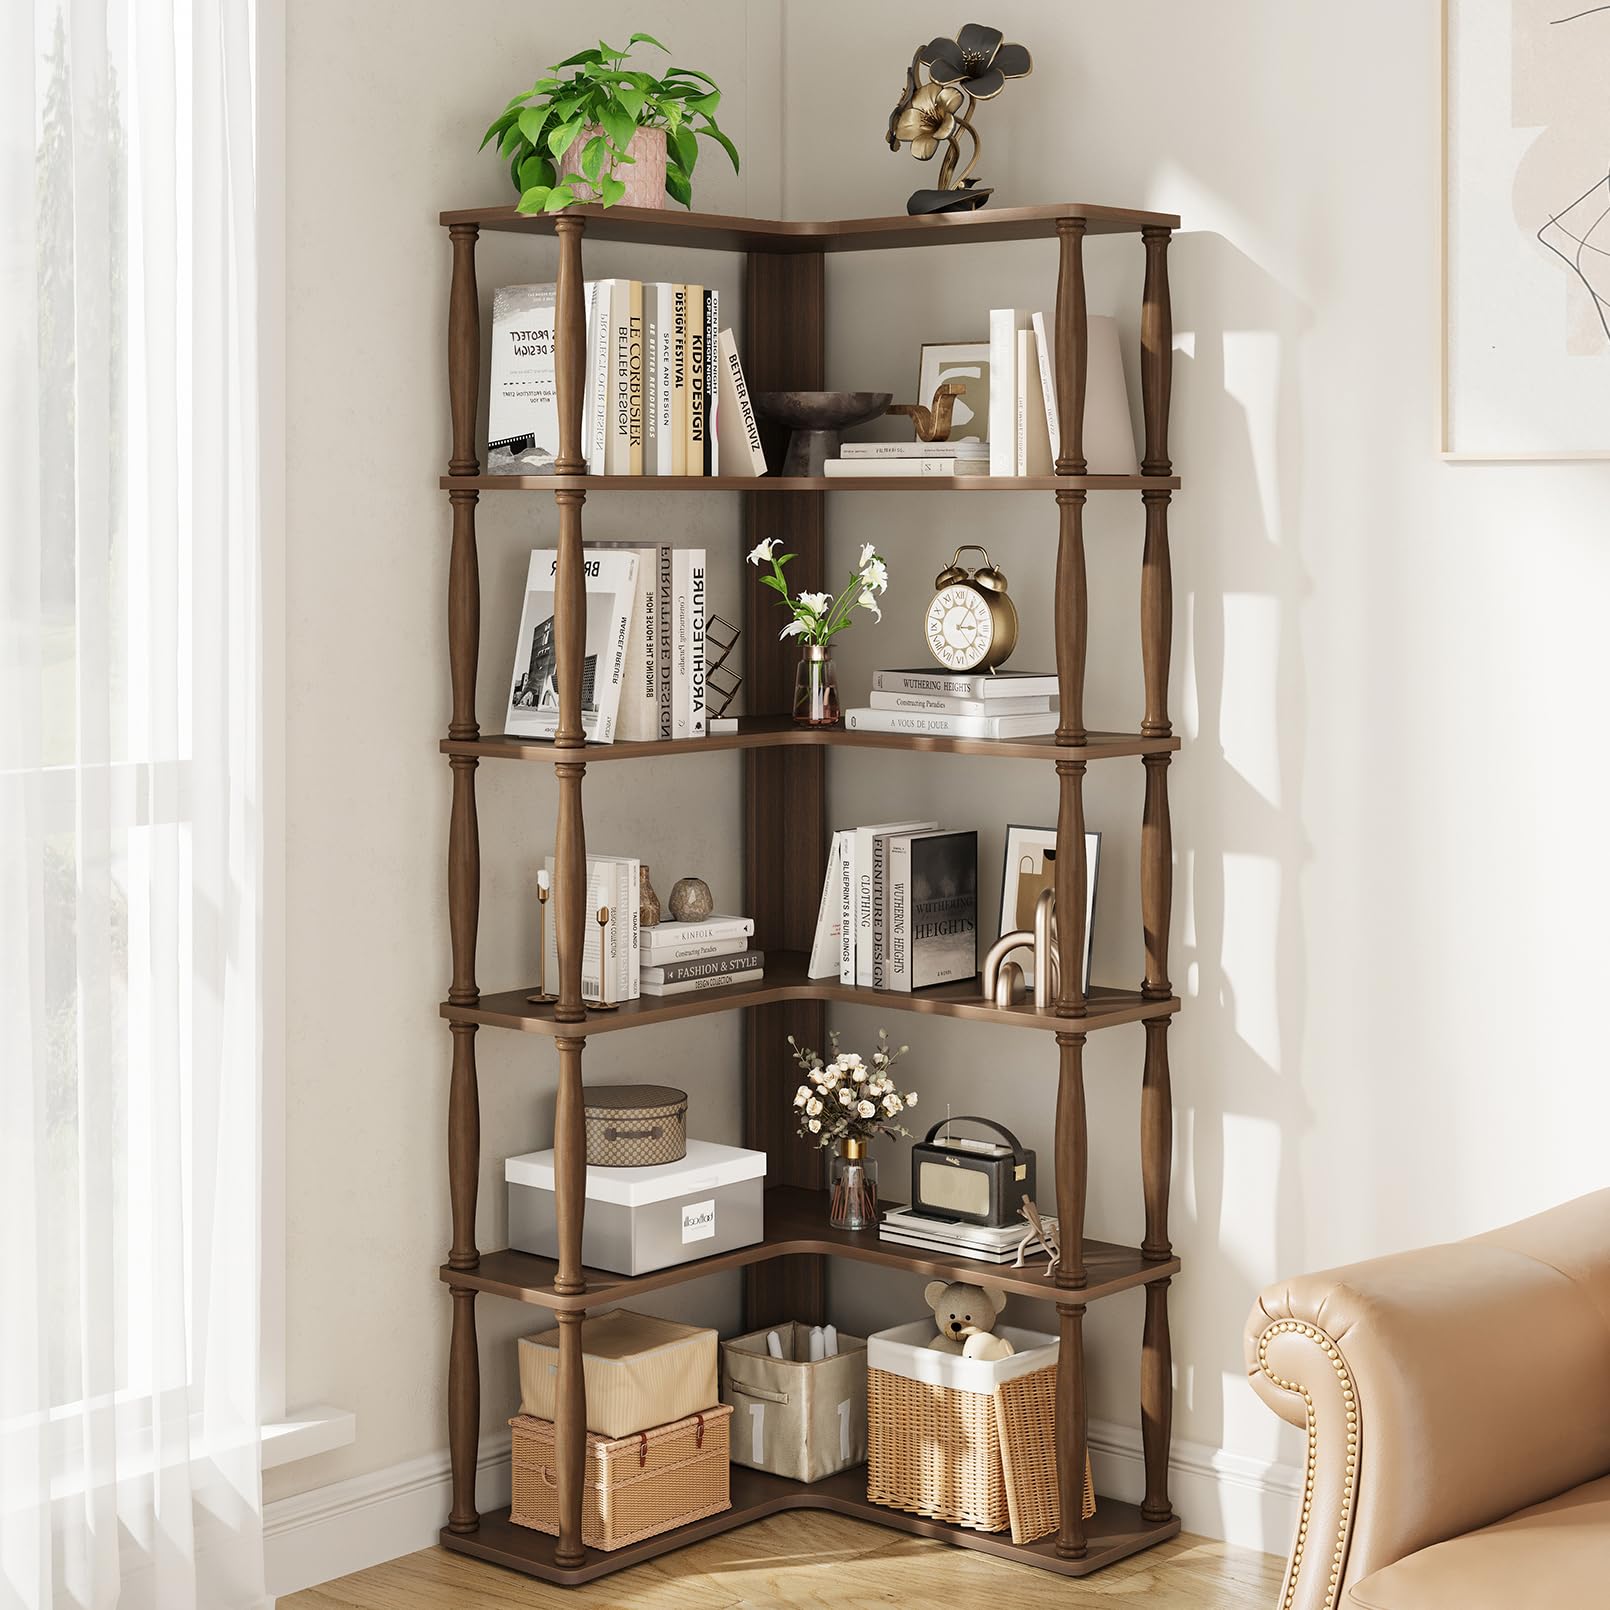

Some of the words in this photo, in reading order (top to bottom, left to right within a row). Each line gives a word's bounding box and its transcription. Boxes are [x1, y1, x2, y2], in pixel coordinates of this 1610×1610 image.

[630, 317, 641, 338] LE
[649, 323, 655, 336] BE
[675, 292, 684, 334] DESIGN
[675, 339, 684, 389] FESTIVAL
[692, 335, 703, 374] KIDS
[630, 343, 641, 447] CORBUSIER
[692, 378, 703, 441] DESIGN
[729, 354, 746, 399] BETTER
[740, 401, 761, 453] ARCHVIZ
[896, 698, 925, 709] Constructing
[903, 678, 941, 691] WUTHERING
[943, 681, 971, 693] HEIGHTS
[890, 719, 895, 727] A
[897, 719, 914, 728] VOUS
[916, 719, 926, 728] DE
[927, 719, 949, 730] JOUER
[842, 861, 850, 910] BLUEPRINTS
[861, 874, 870, 928] CLOTHING
[873, 838, 883, 927] FURNITURE
[894, 883, 904, 934] WUTHERING
[916, 898, 973, 915] WUTHERING
[681, 929, 713, 940] KINFOLK
[842, 919, 850, 962] BUILDINGS
[915, 917, 974, 940] HEIGHTS
[677, 963, 719, 979] FASHION
[720, 961, 728, 972] &
[729, 956, 758, 971] STYLE
[873, 932, 883, 988] DESIGN
[894, 938, 904, 974] HEIGHTS
[695, 978, 710, 989] DESIGN
[710, 976, 733, 987] COLLECTION
